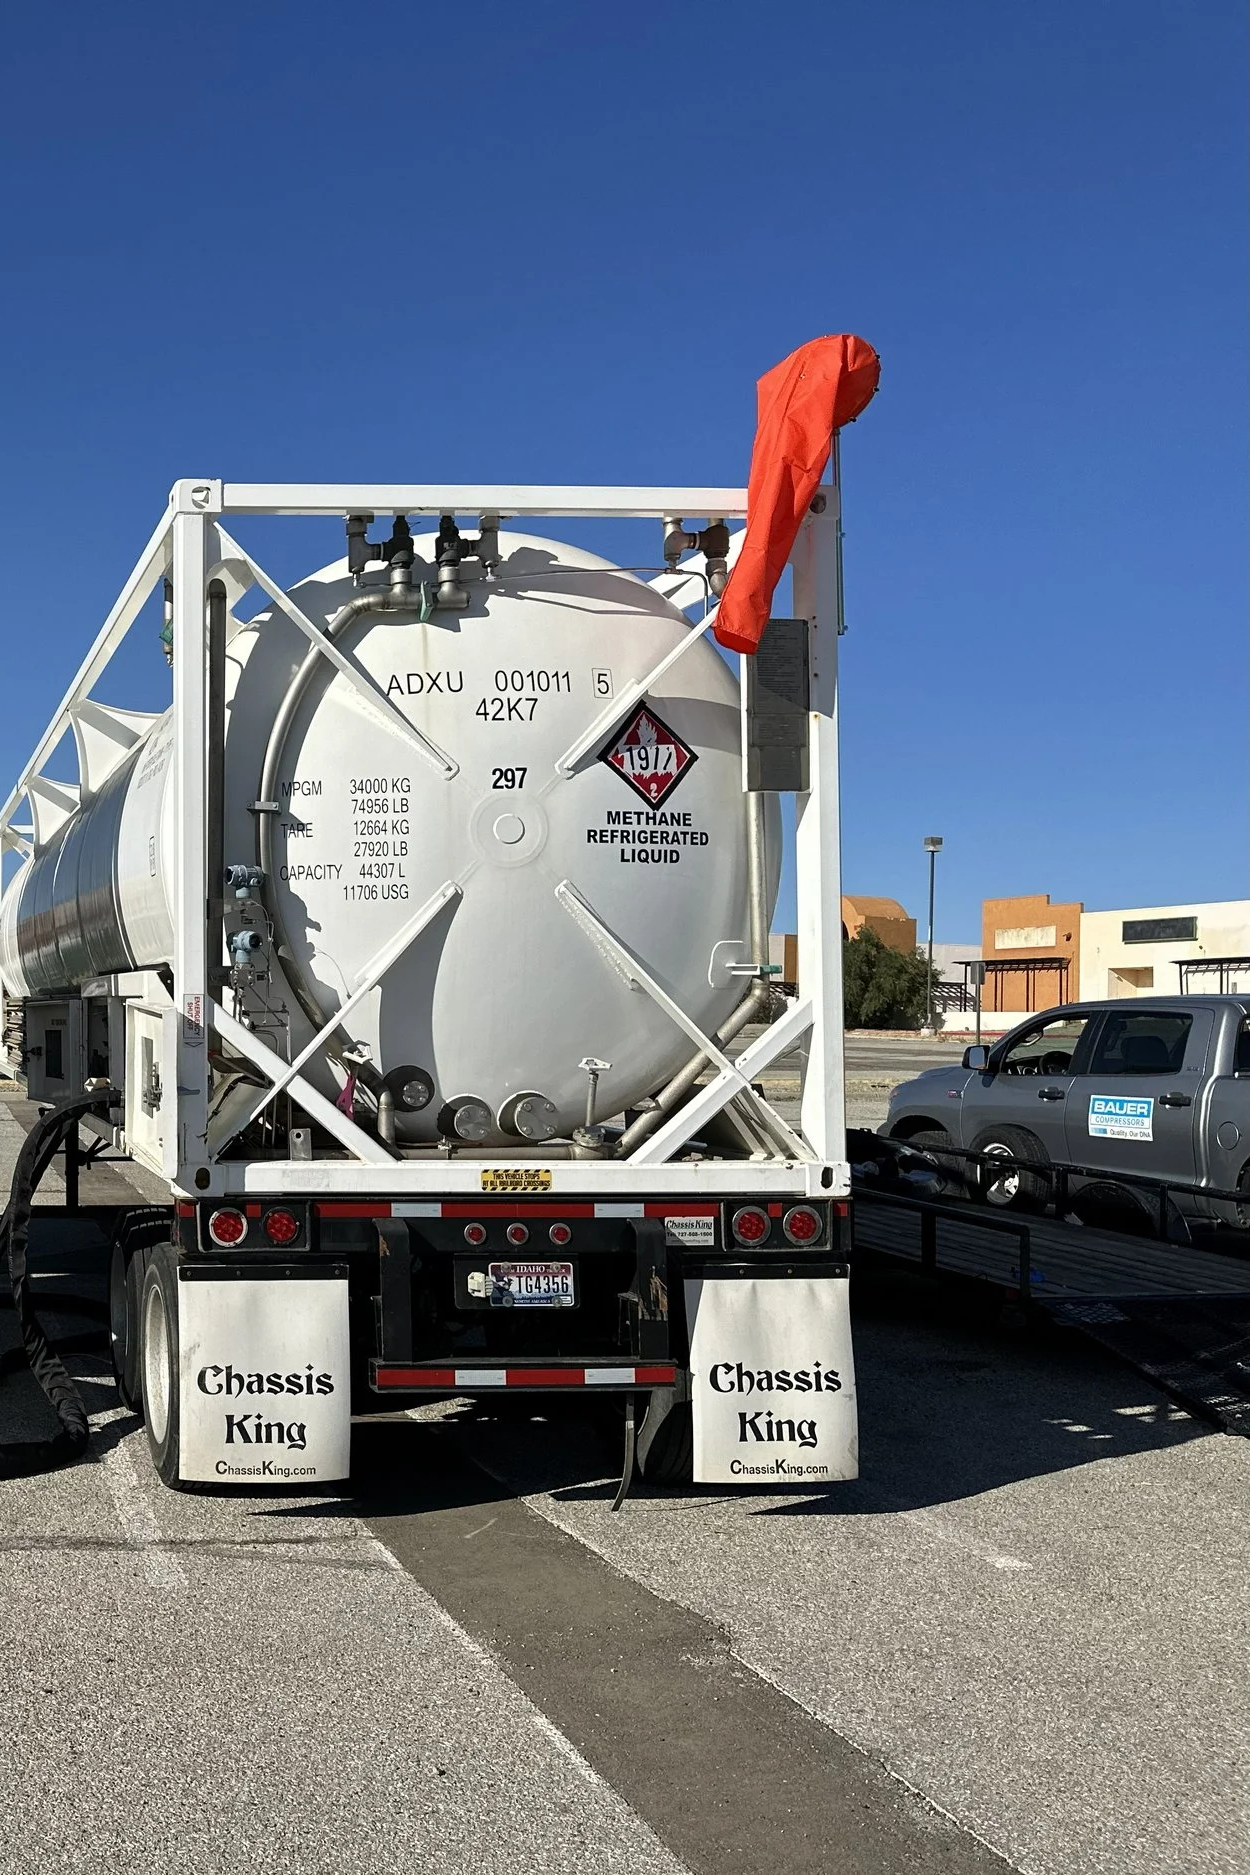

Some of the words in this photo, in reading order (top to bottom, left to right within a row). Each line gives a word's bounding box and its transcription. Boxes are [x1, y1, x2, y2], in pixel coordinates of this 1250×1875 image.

[387, 671, 464, 696] ADXU
[495, 670, 571, 693] 001011
[597, 673, 610, 695] 5
[475, 697, 538, 721] 42K7
[281, 780, 322, 796] MPGM
[349, 778, 388, 794] 34000
[392, 777, 411, 793] KG
[491, 767, 528, 789] 297
[650, 782, 658, 797] 2
[351, 798, 389, 814] 74956
[392, 798, 409, 813] LB
[606, 811, 693, 827] METHANE
[280, 822, 313, 838] TARE
[353, 820, 388, 835] 12664
[392, 819, 410, 835] KG
[586, 829, 709, 846] REFRIGERATED
[353, 841, 389, 857] 27920
[393, 841, 408, 856] LB
[620, 848, 681, 864] LIQUID
[359, 862, 395, 878] 44307
[398, 863, 406, 878] L
[343, 884, 378, 900] 11706
[381, 884, 409, 900] USG
[1093, 1100, 1148, 1116] BAUER
[1095, 1115, 1145, 1127] COMPRESSORS
[666, 1220, 694, 1229] Chassis
[695, 1219, 713, 1230] King
[515, 1265, 546, 1273] IDAHO
[516, 1275, 569, 1294] TG4356
[197, 1364, 335, 1398] Chassis
[709, 1361, 842, 1396] Chassis
[225, 1413, 307, 1450] King
[738, 1410, 818, 1448] King
[215, 1460, 317, 1478] ChassisKing.com
[730, 1459, 829, 1476] ChassisKing.com
